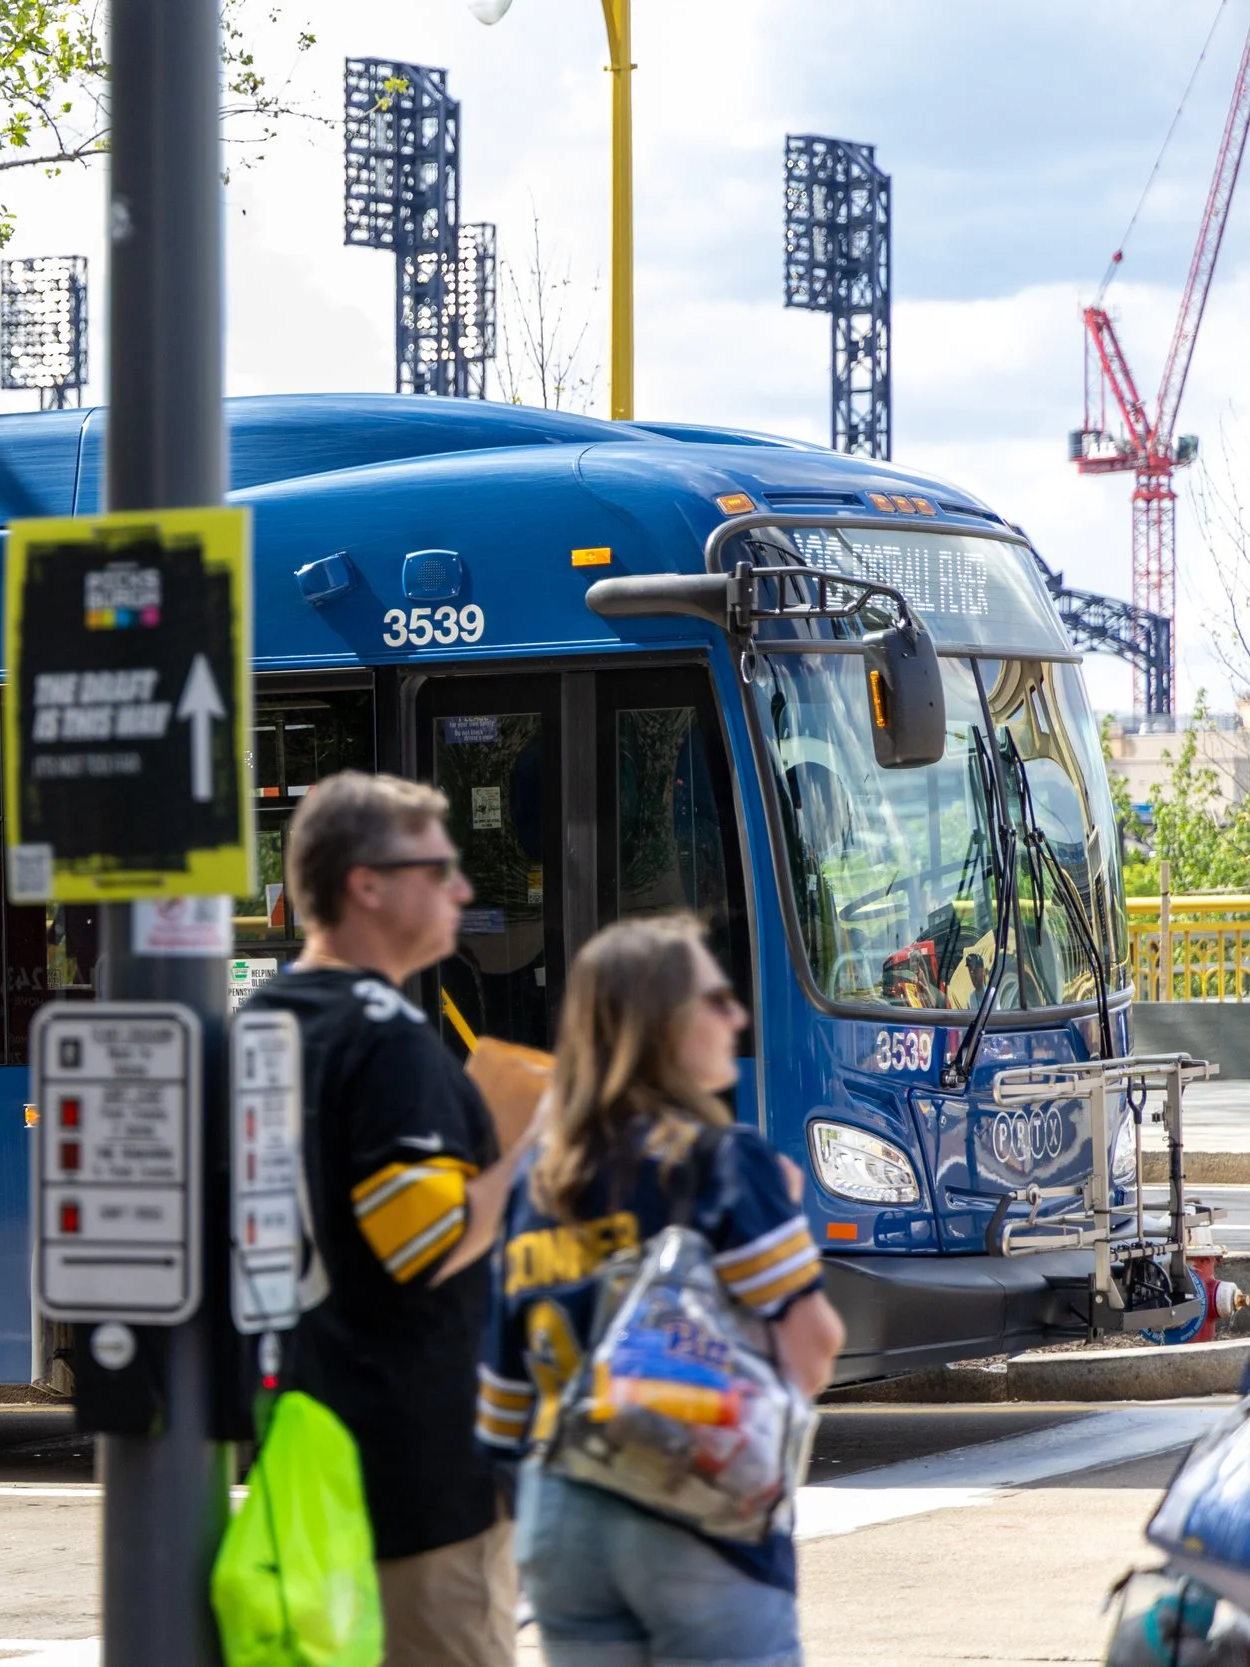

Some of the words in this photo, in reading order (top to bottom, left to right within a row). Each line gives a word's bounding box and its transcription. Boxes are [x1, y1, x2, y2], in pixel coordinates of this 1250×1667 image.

[383, 604, 485, 647] 3539
[34, 673, 78, 706] THE
[79, 669, 159, 704] DRAFT
[32, 707, 60, 742] IS
[61, 705, 112, 741] THIS
[251, 969, 276, 978] HELPING
[877, 1030, 932, 1072] 3539
[999, 1118, 1058, 1152] PRTX
